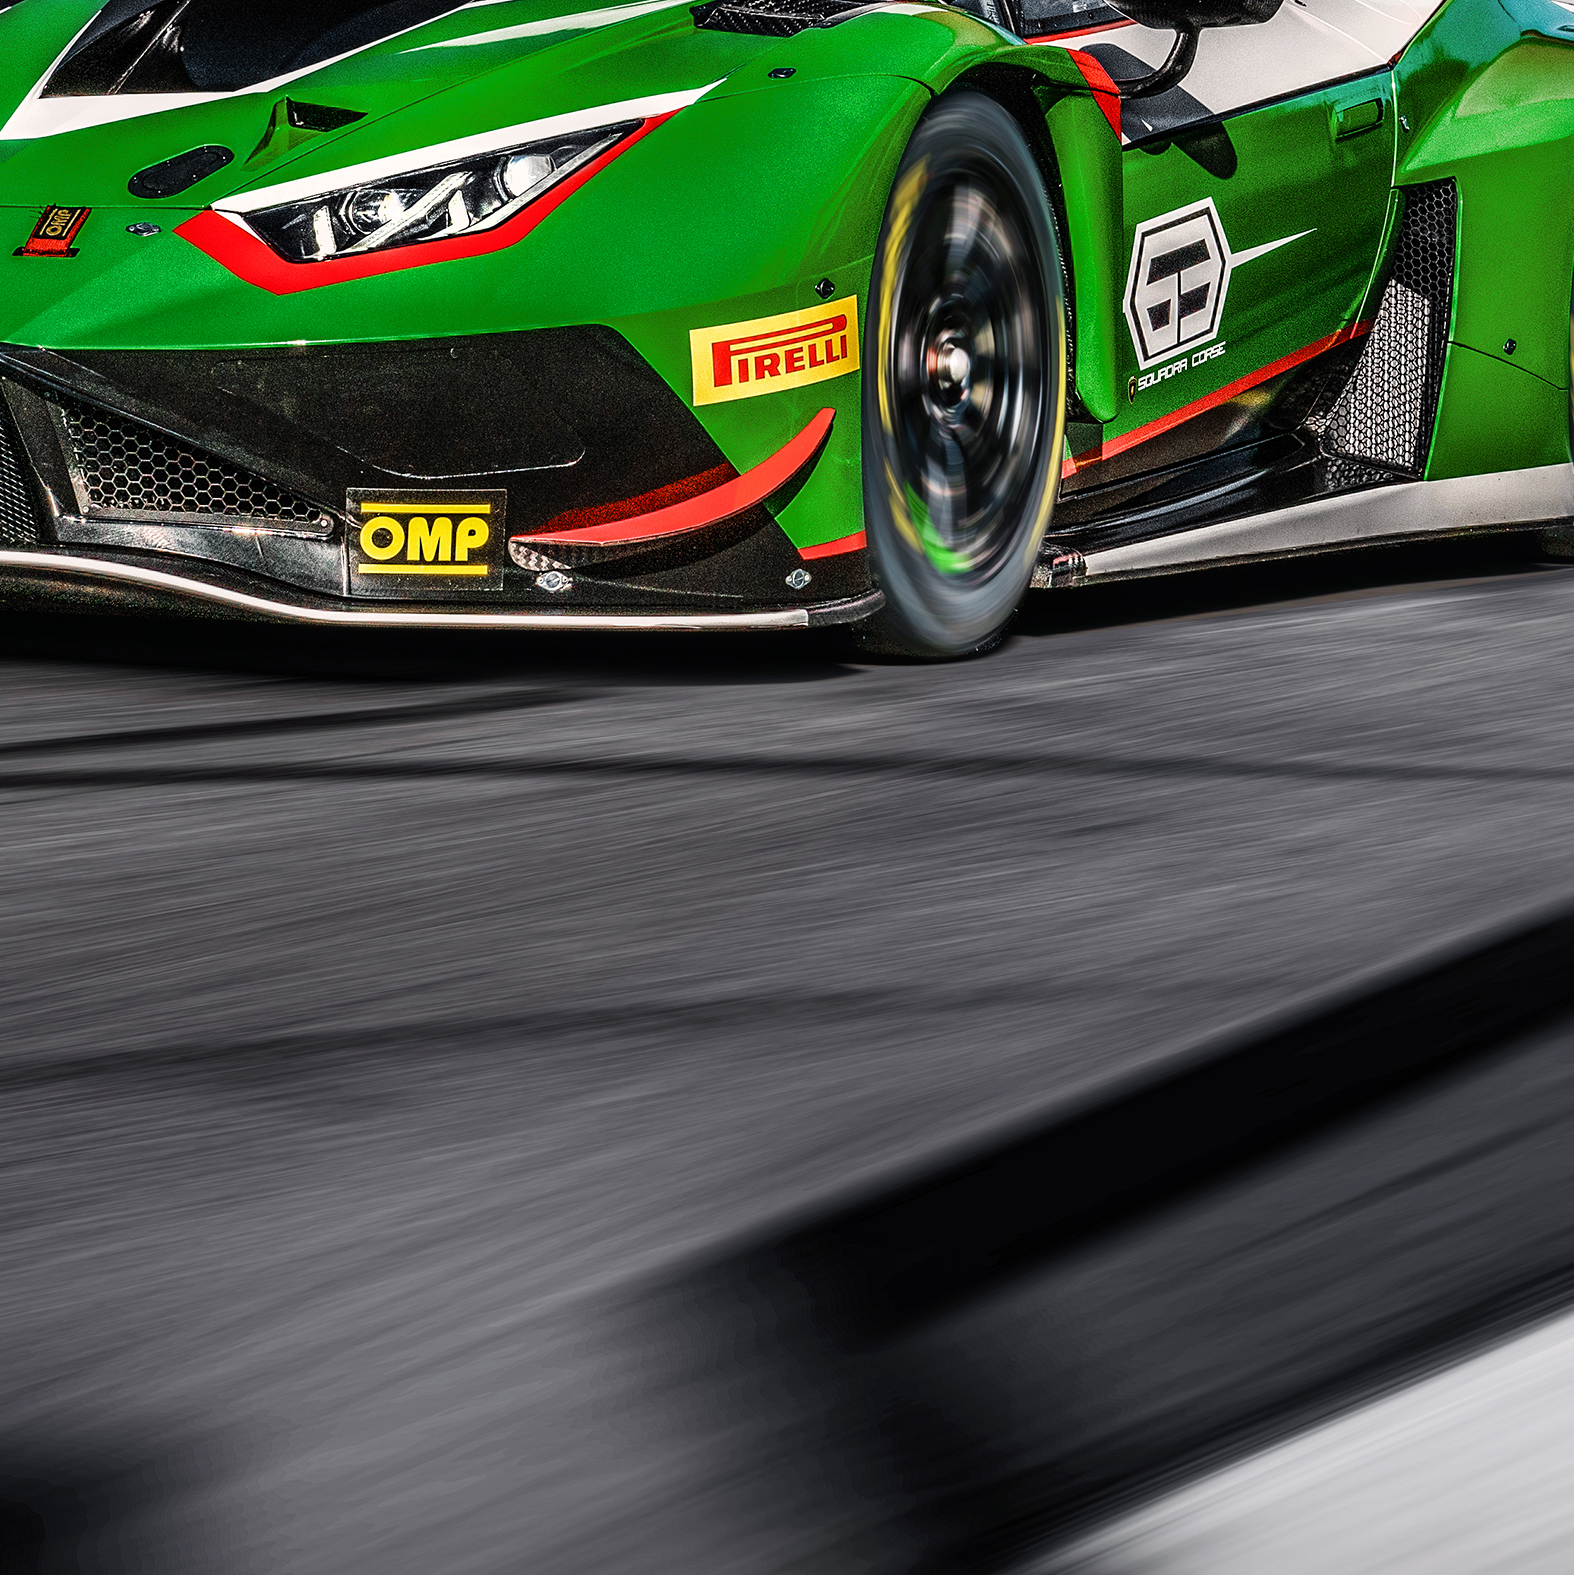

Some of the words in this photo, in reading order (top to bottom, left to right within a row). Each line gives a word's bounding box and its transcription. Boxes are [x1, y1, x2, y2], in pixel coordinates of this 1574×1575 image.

[45, 209, 72, 236] OMP
[712, 314, 848, 387] PIRELLI
[1138, 358, 1187, 391] SQUADRA
[1192, 341, 1226, 367] CORSE
[360, 516, 489, 561] OMP
